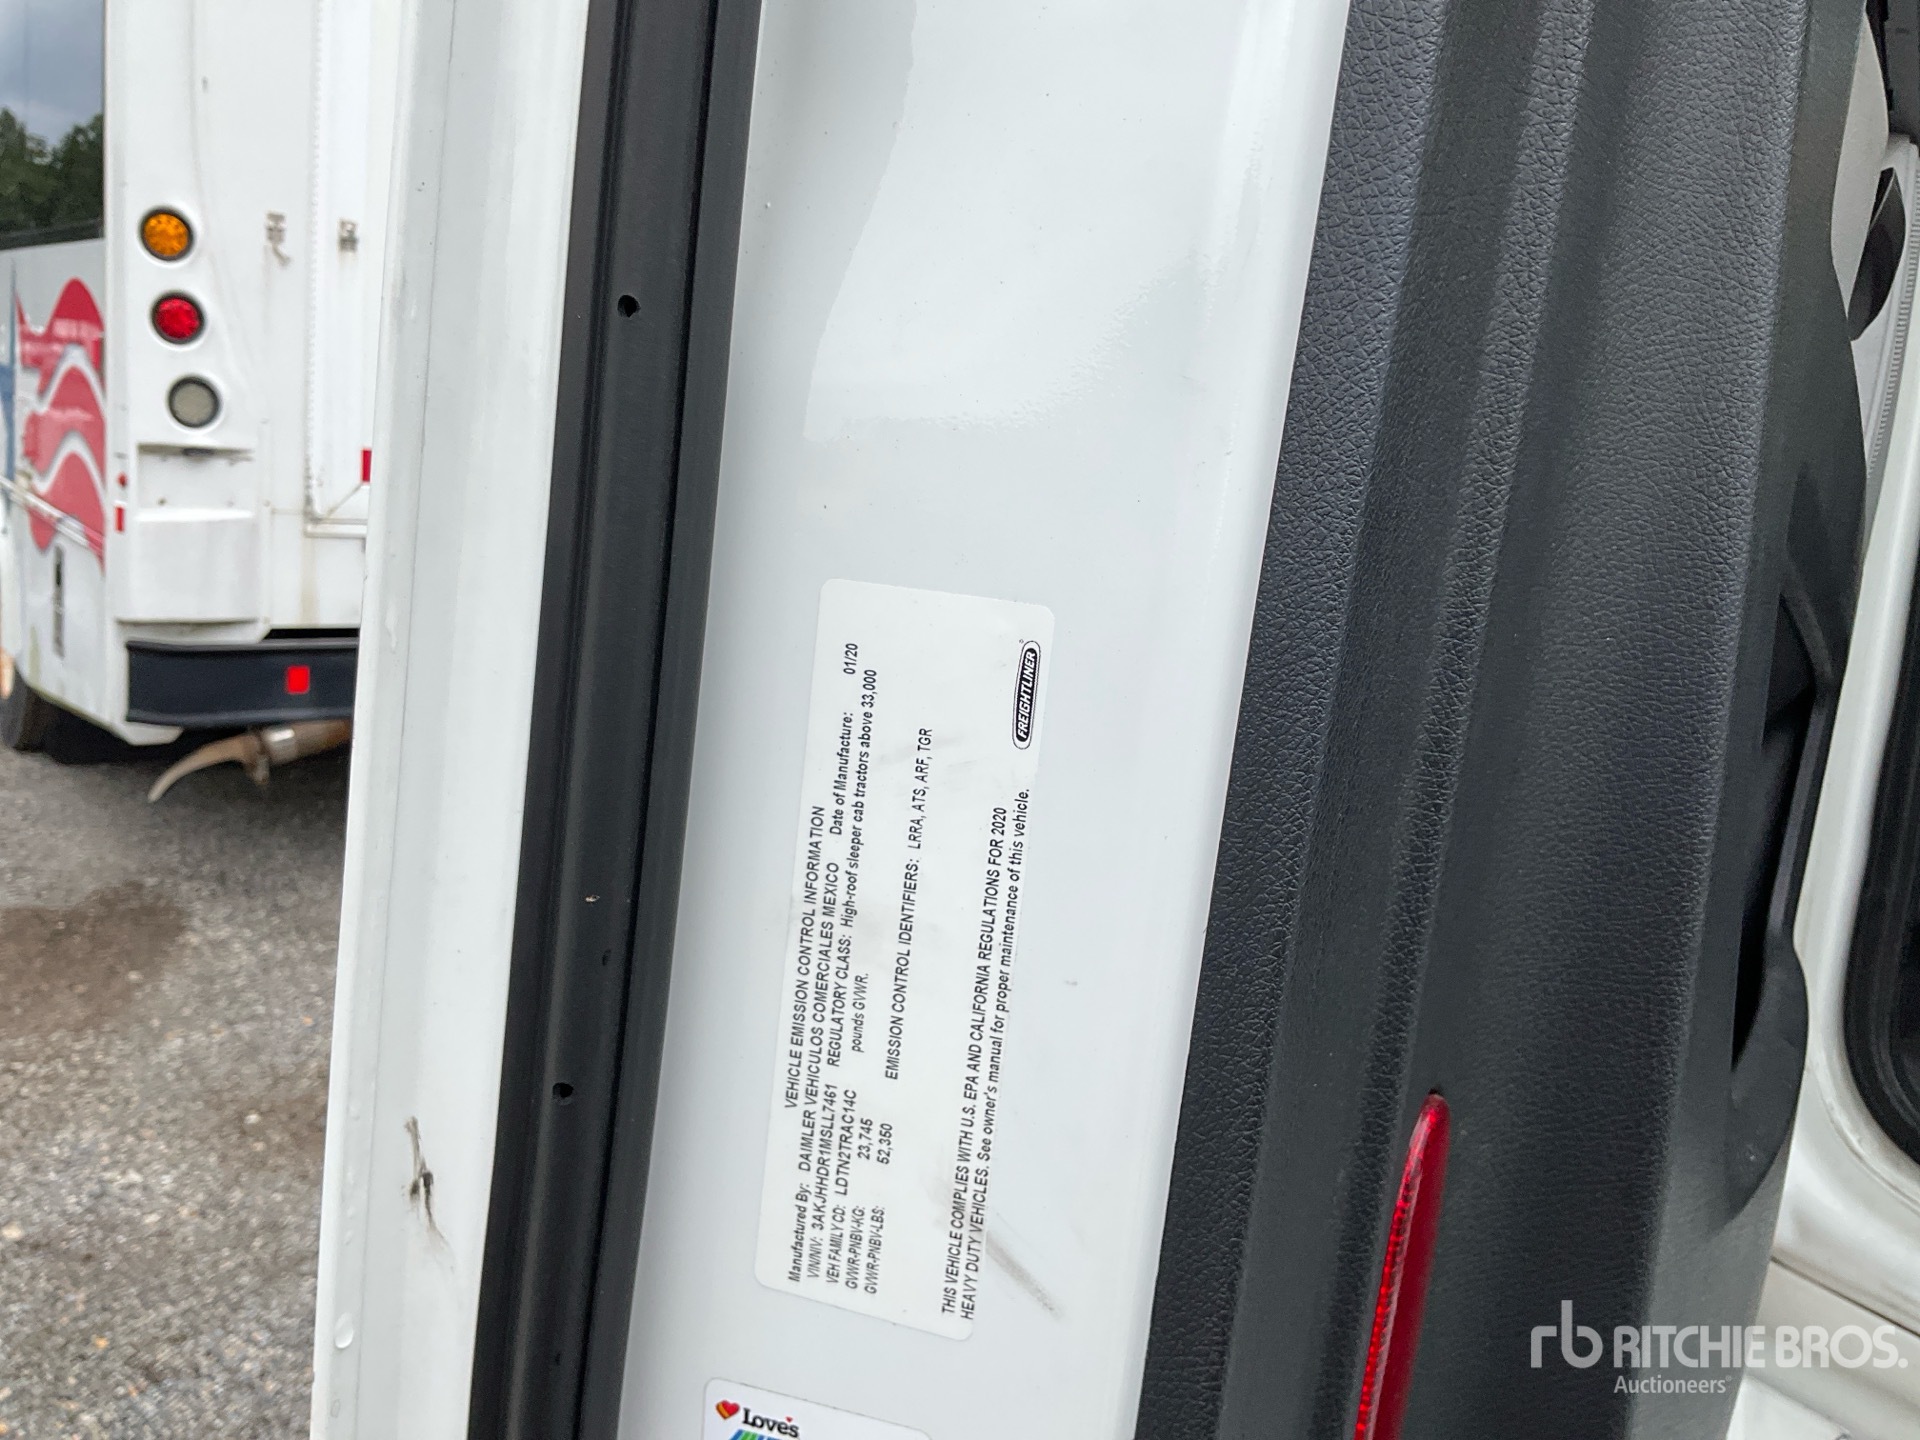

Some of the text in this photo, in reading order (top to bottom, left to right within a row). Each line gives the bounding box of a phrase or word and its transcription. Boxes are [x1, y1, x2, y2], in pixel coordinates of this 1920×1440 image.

[843, 643, 858, 674] 01/20
[1017, 650, 1035, 739] FREIGHTLINER
[829, 712, 853, 835] Date of Manufacture:
[785, 806, 825, 1108] VEHICLE EMISSION CONTROL INFORMATION
[827, 670, 877, 1067] REGULATORY CLASS: High-roof sleeper cab tractors above 33,000
[885, 728, 932, 1080] EMISSION CONTROL IDENTIFIERS: LRRA, ATS, ARF, TGR
[788, 863, 839, 1282] Manufactured By: DAIMLER VEHICULOS COMERCIALES MEXICO
[850, 973, 868, 1053] pounds GVWR.
[941, 807, 1007, 1313] THIS VEHICLE COMPLIES WITH U.S. EPA AND CALIFORNIA REGULATIONS FOR 2020
[961, 789, 1029, 1320] HEAVY DUTY VEHICLES. See owner's manual for proper maintenance of this vehicle.
[807, 1237, 823, 1277] VIN/NIV:
[825, 1090, 856, 1283] VEH FAMILY CD: LDTN2TRAC14C
[845, 1118, 873, 1289] GVWR-PNBV-KG: 23,745
[864, 1123, 893, 1294] GVWR-PNBV-LBS: 52,350
